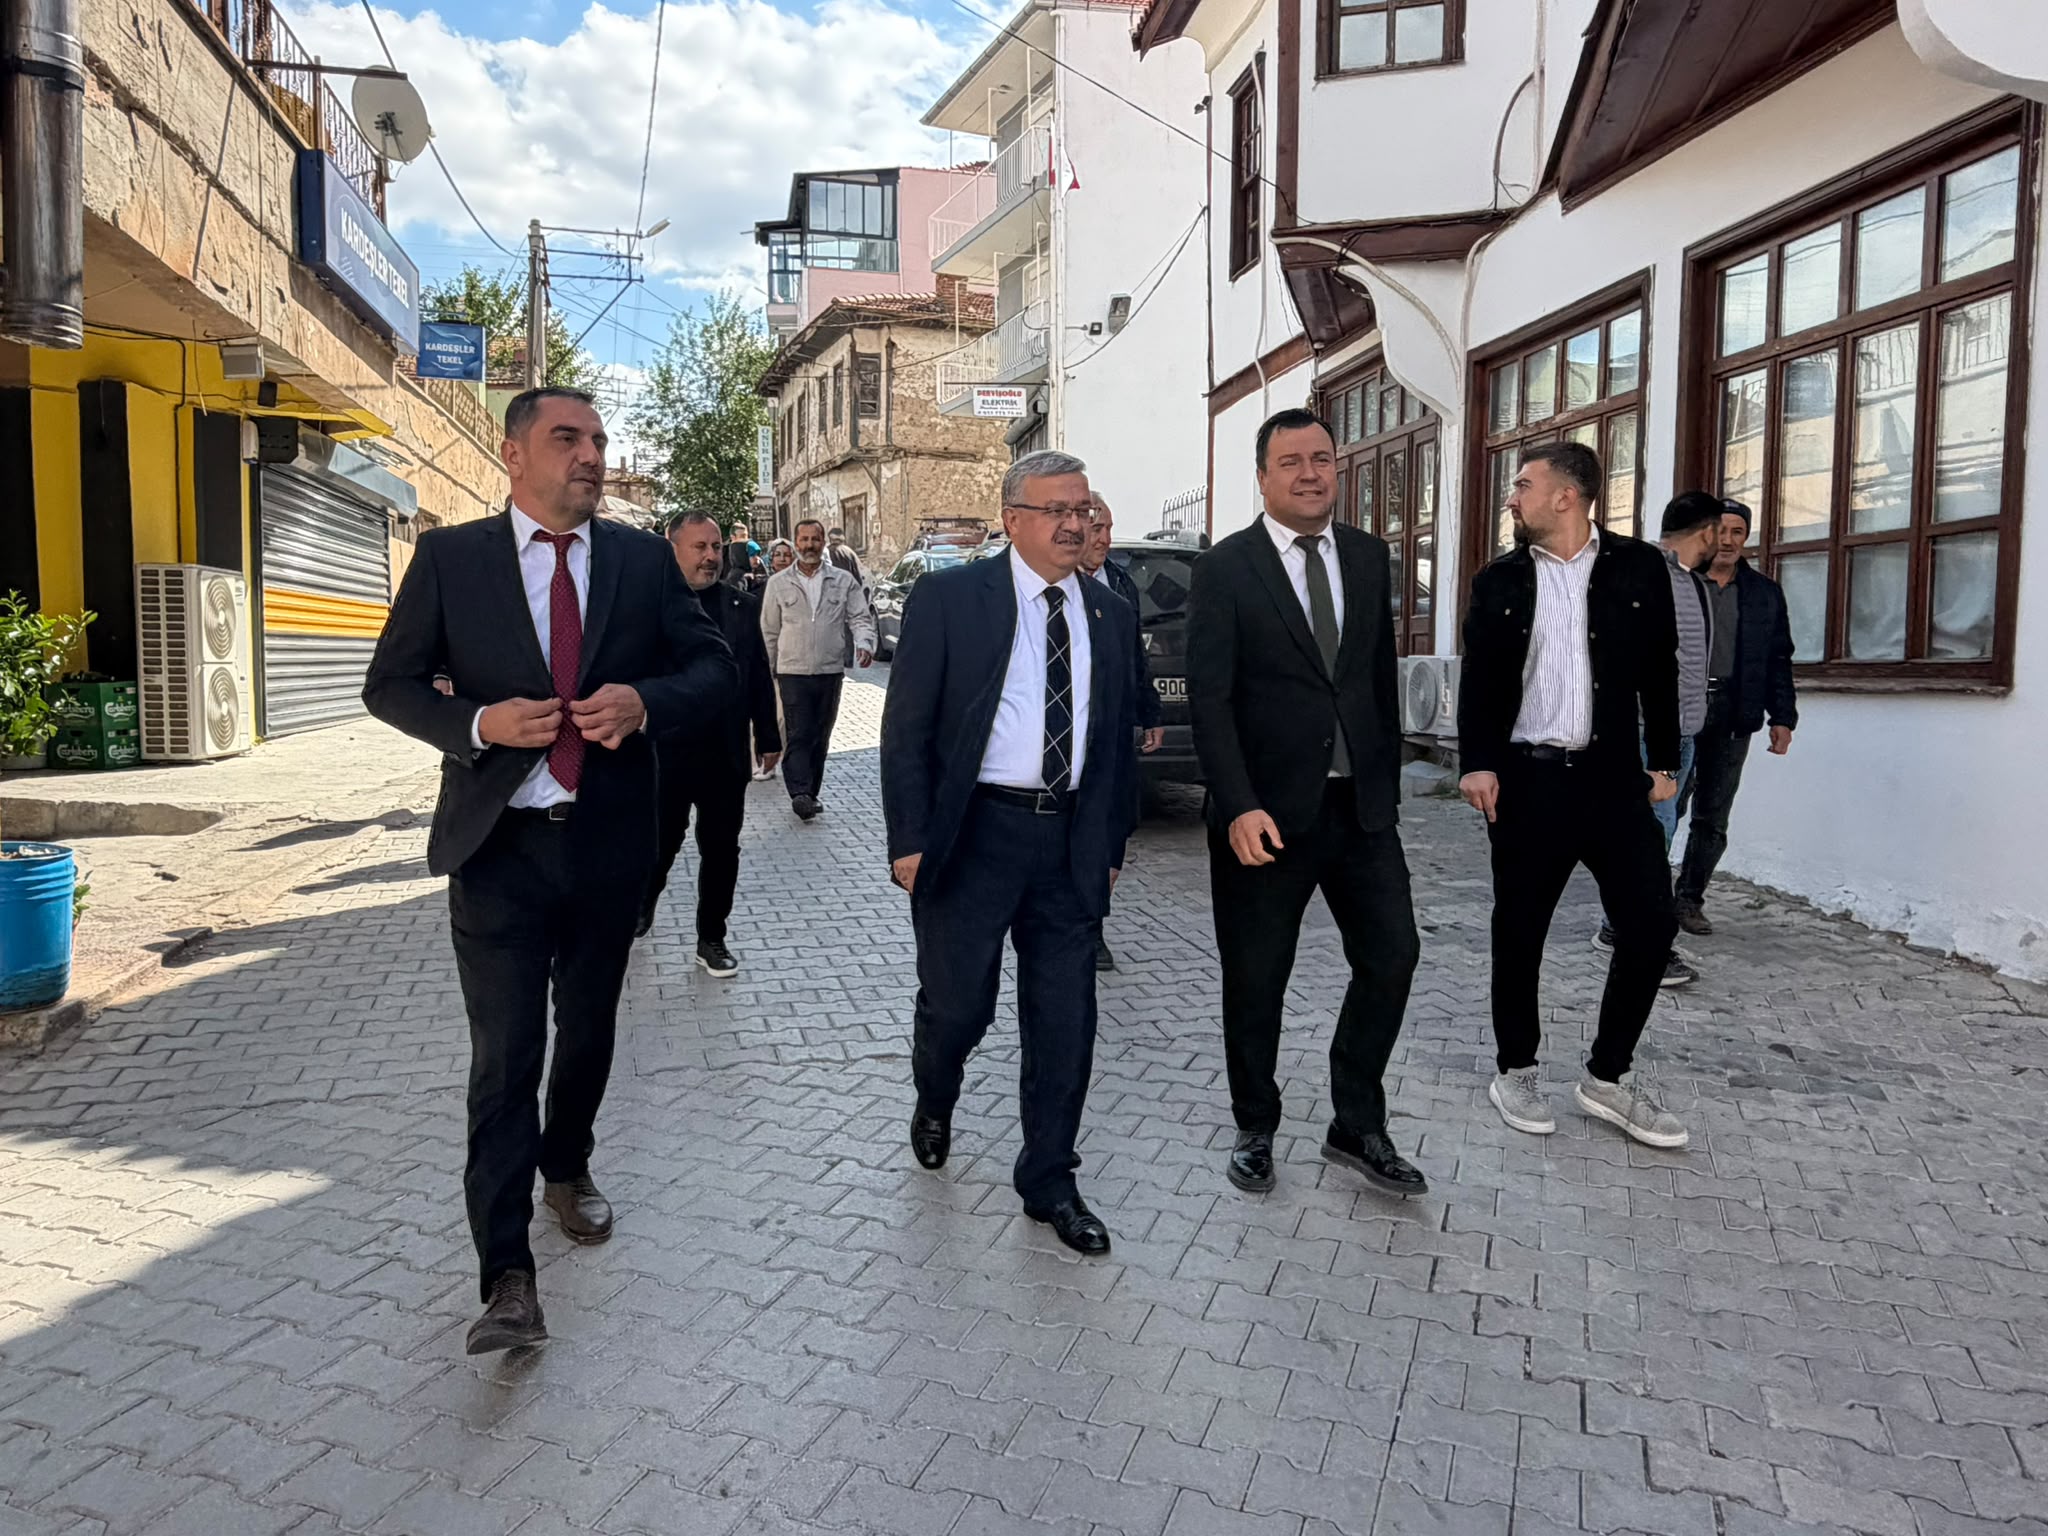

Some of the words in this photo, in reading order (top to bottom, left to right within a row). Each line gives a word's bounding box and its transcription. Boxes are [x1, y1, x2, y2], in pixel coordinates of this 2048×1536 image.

[342, 207, 388, 285] KARDEŞLER
[388, 261, 409, 309] TEKEL
[425, 343, 475, 354] KARDEŞLER
[437, 355, 464, 365] TEKEL
[57, 744, 97, 761] Carlsberg
